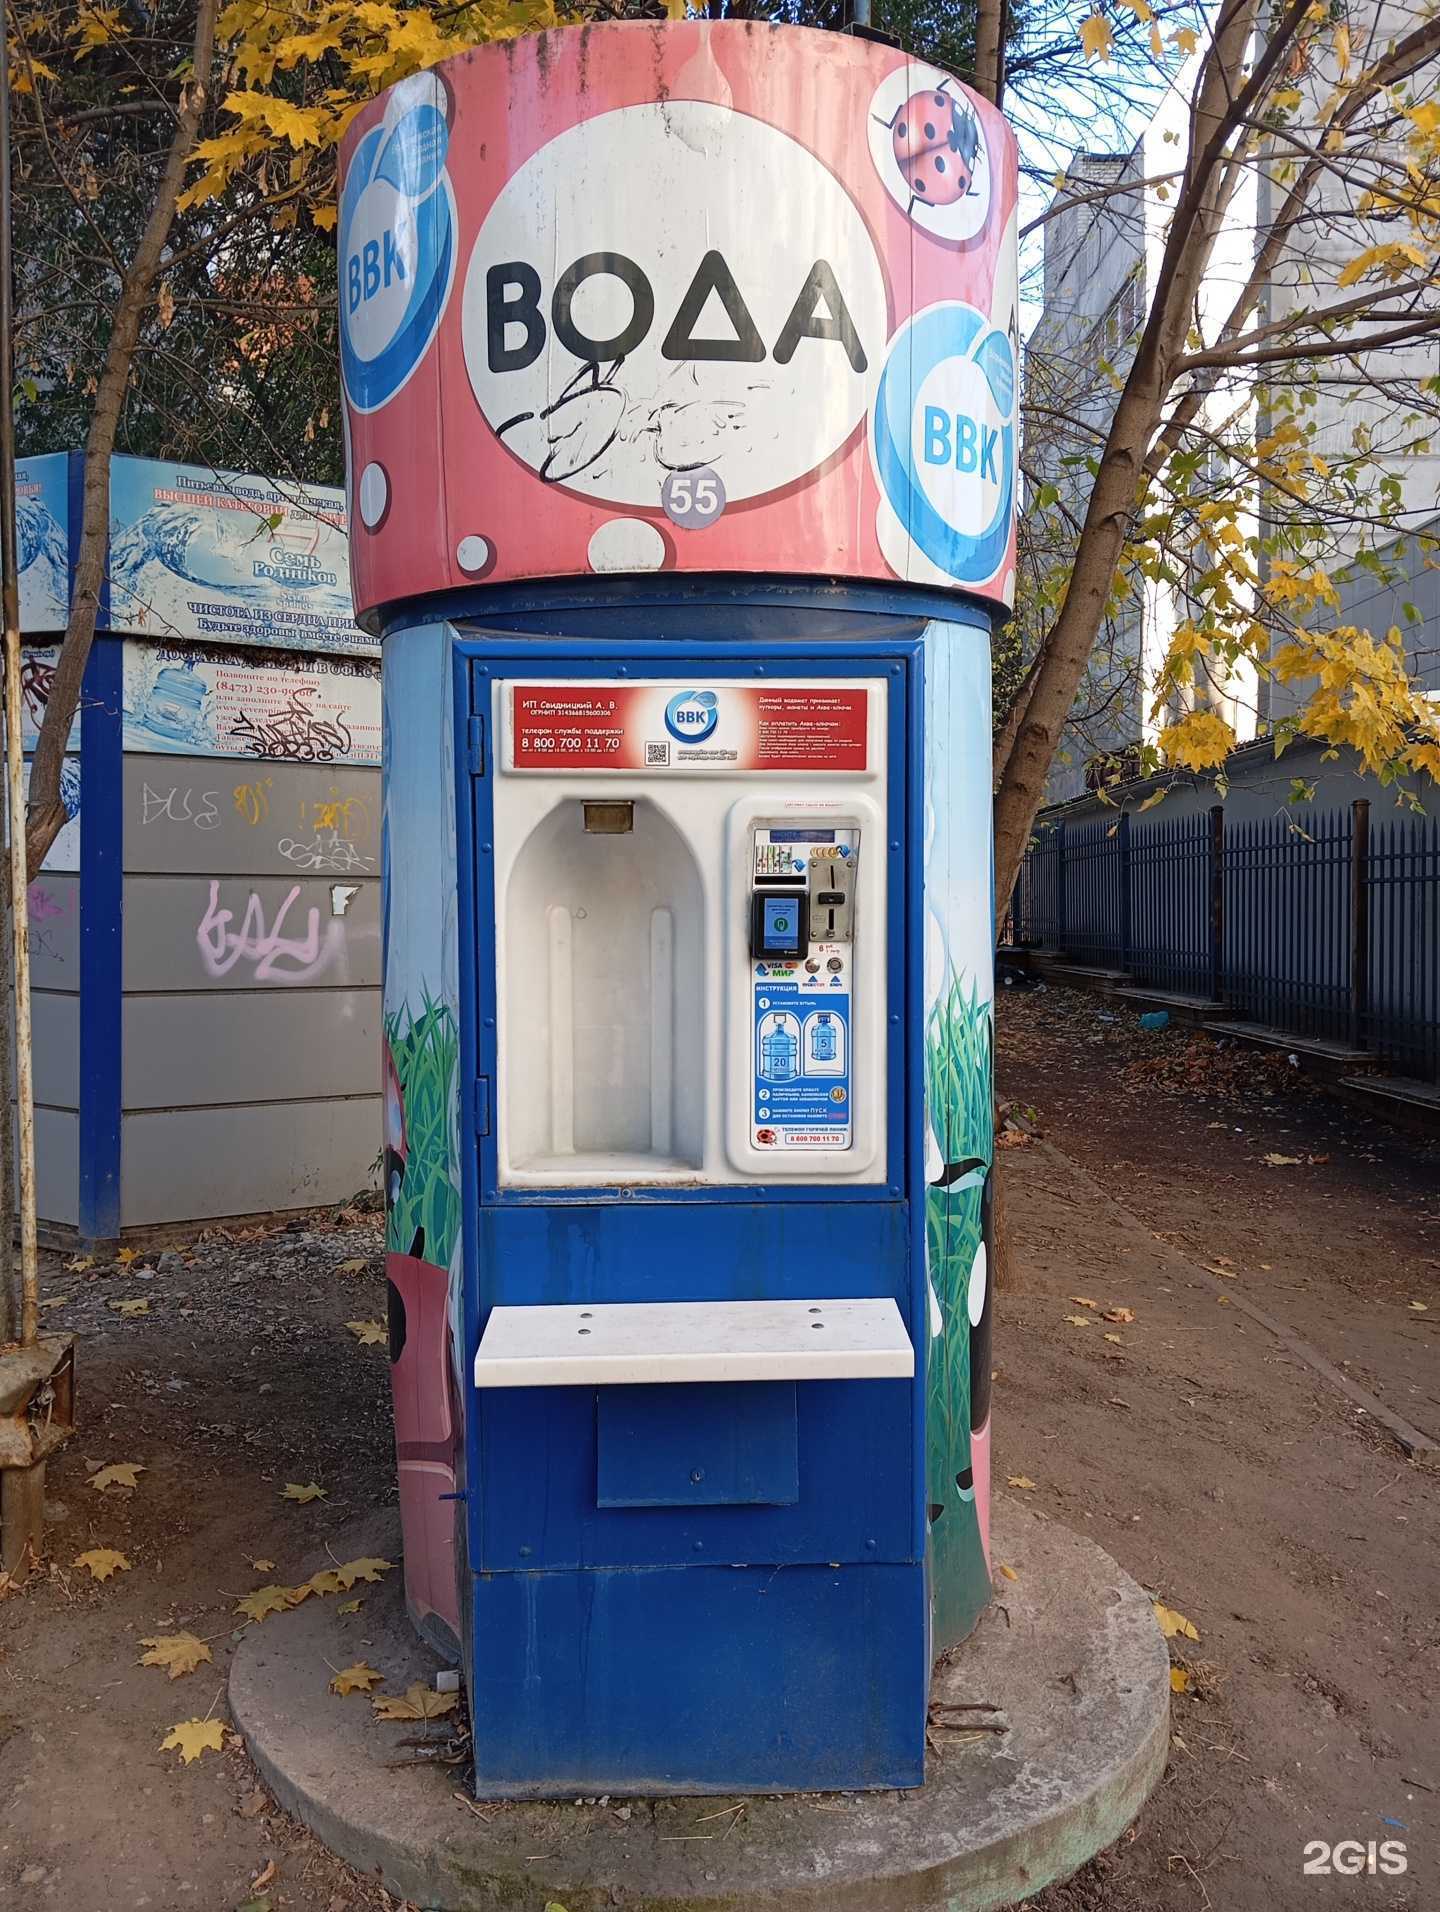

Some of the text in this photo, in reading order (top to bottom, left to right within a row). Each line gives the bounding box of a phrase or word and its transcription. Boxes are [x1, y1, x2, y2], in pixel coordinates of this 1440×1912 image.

[486, 250, 868, 373] ВОДА
[669, 480, 718, 514] 55
[269, 547, 322, 570] Семь
[253, 561, 338, 587] Родников
[187, 602, 252, 620] ЧИСТОТА
[253, 608, 272, 622] ИЗ
[274, 611, 326, 627] СЕРДЦА
[199, 618, 241, 634] Будьте
[242, 625, 296, 639] здоровы
[299, 630, 341, 644] вместе
[216, 681, 253, 694] (8473)
[522, 700, 618, 710] ИП Свидницкий А. В.
[521, 728, 624, 737] телефон службы поддержки
[521, 738, 620, 749] 8 800 700 11 70
[821, 1039, 827, 1048] 5
[773, 1058, 786, 1067] 20
